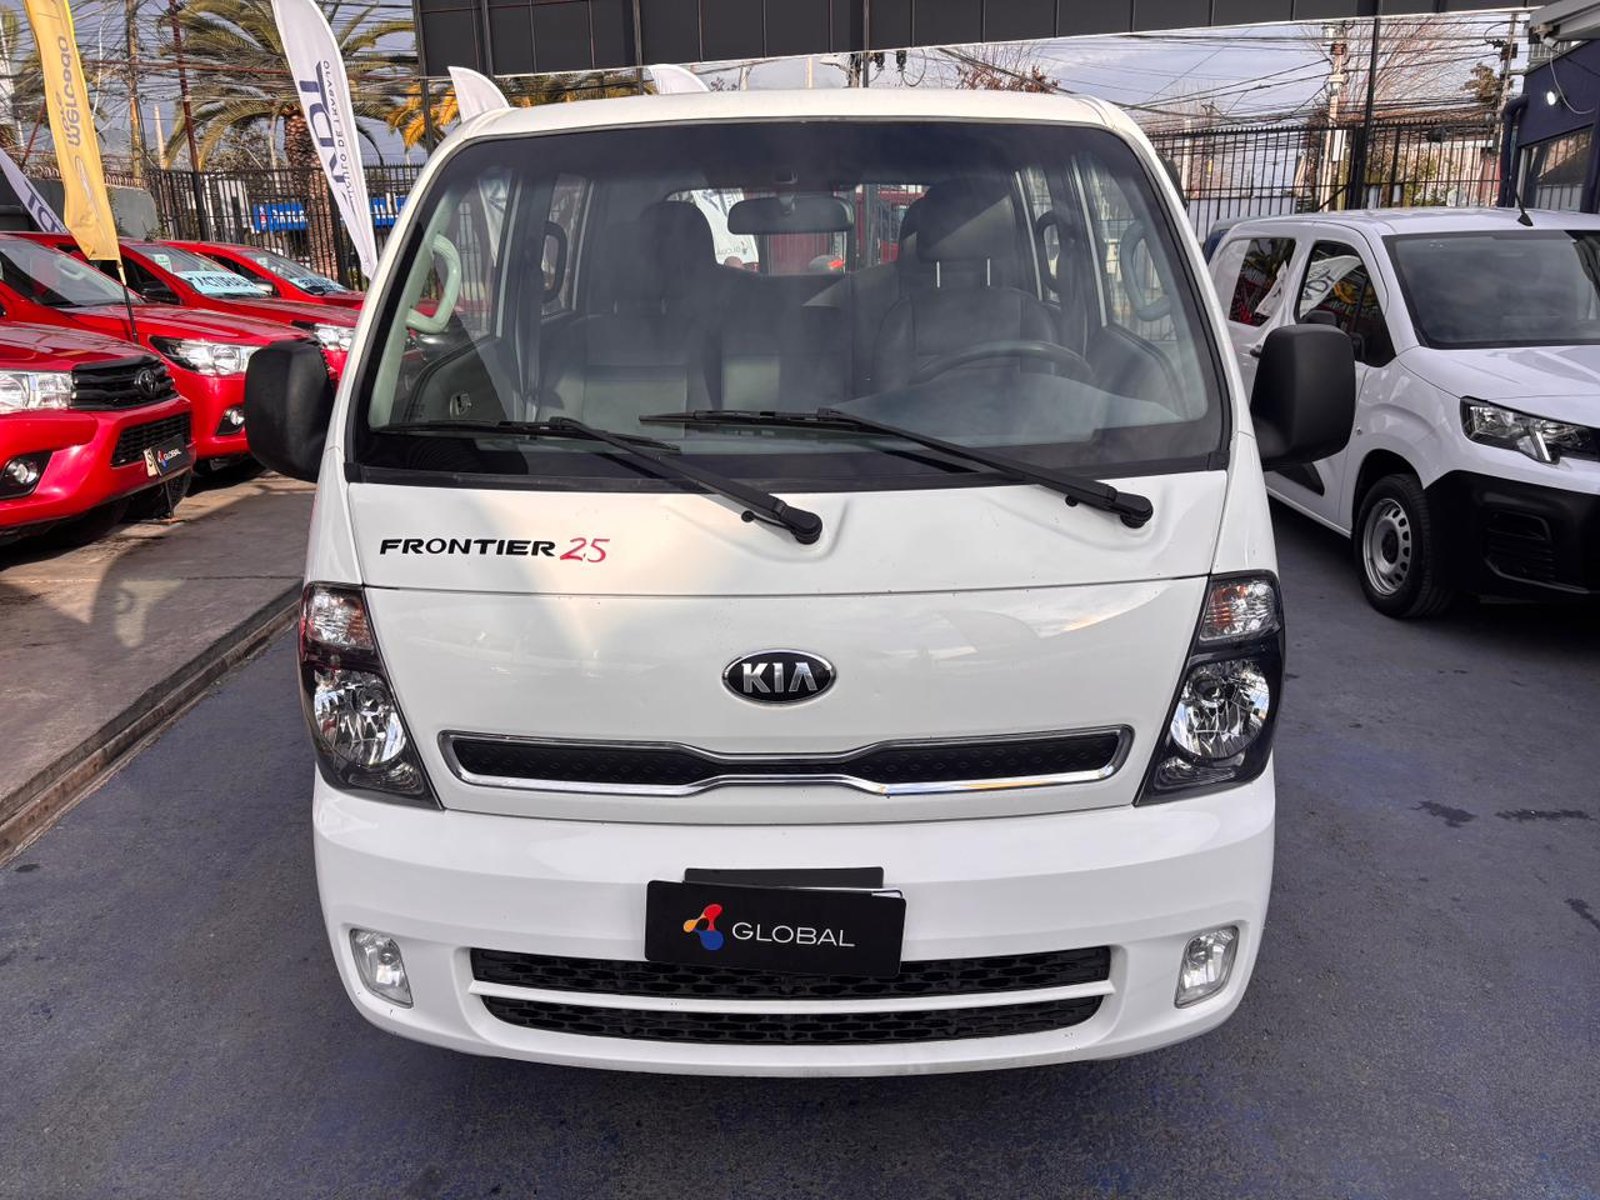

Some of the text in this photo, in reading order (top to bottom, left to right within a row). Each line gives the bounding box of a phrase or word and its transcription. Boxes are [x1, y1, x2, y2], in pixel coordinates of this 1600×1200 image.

[379, 538, 556, 557] FRONTIER
[741, 662, 819, 693] KIA
[732, 922, 856, 947] GLOBAL
